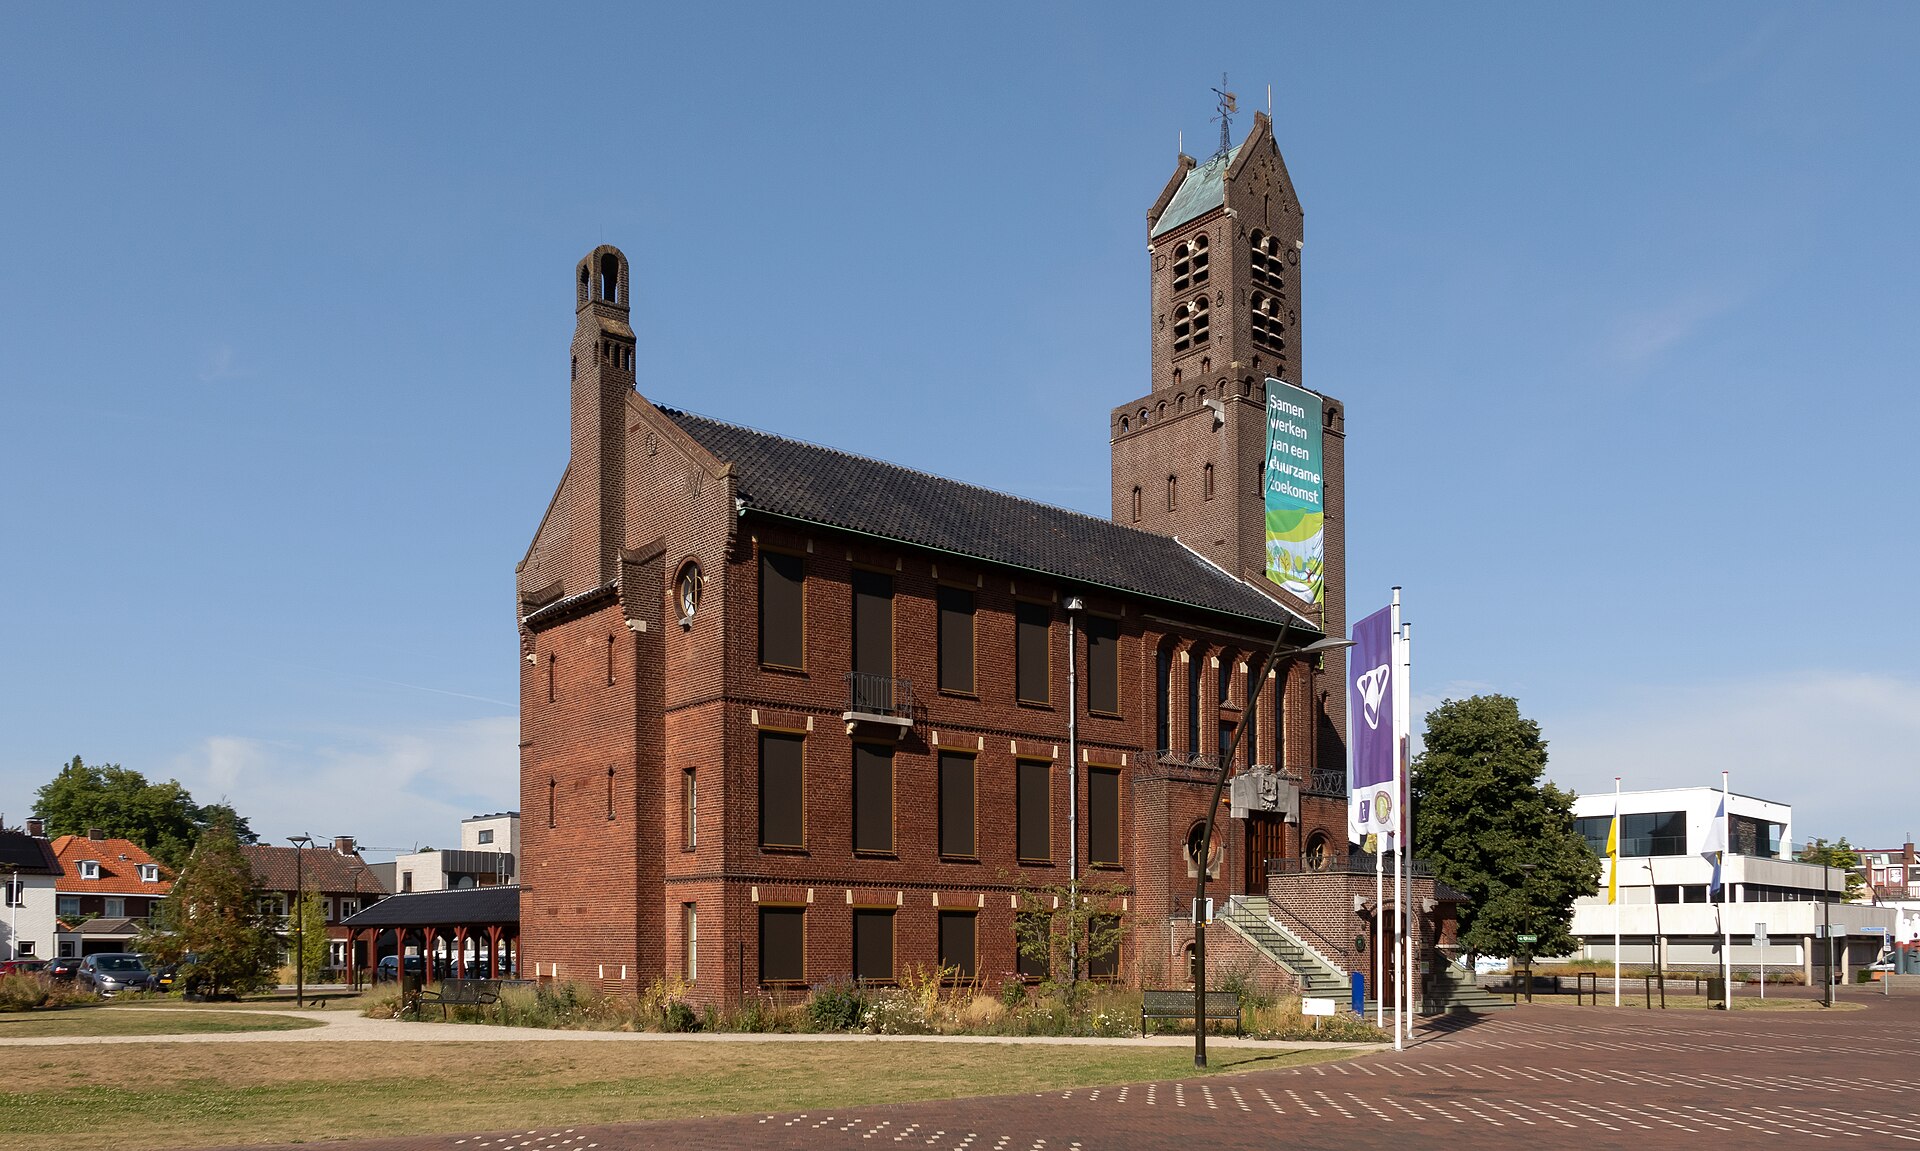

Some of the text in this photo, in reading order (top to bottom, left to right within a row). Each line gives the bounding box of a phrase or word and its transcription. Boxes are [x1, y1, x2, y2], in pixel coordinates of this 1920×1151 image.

[1270, 394, 1304, 418] Samen
[1270, 418, 1307, 440] werken
[1290, 445, 1309, 460] een
[1269, 456, 1320, 484] duurzame
